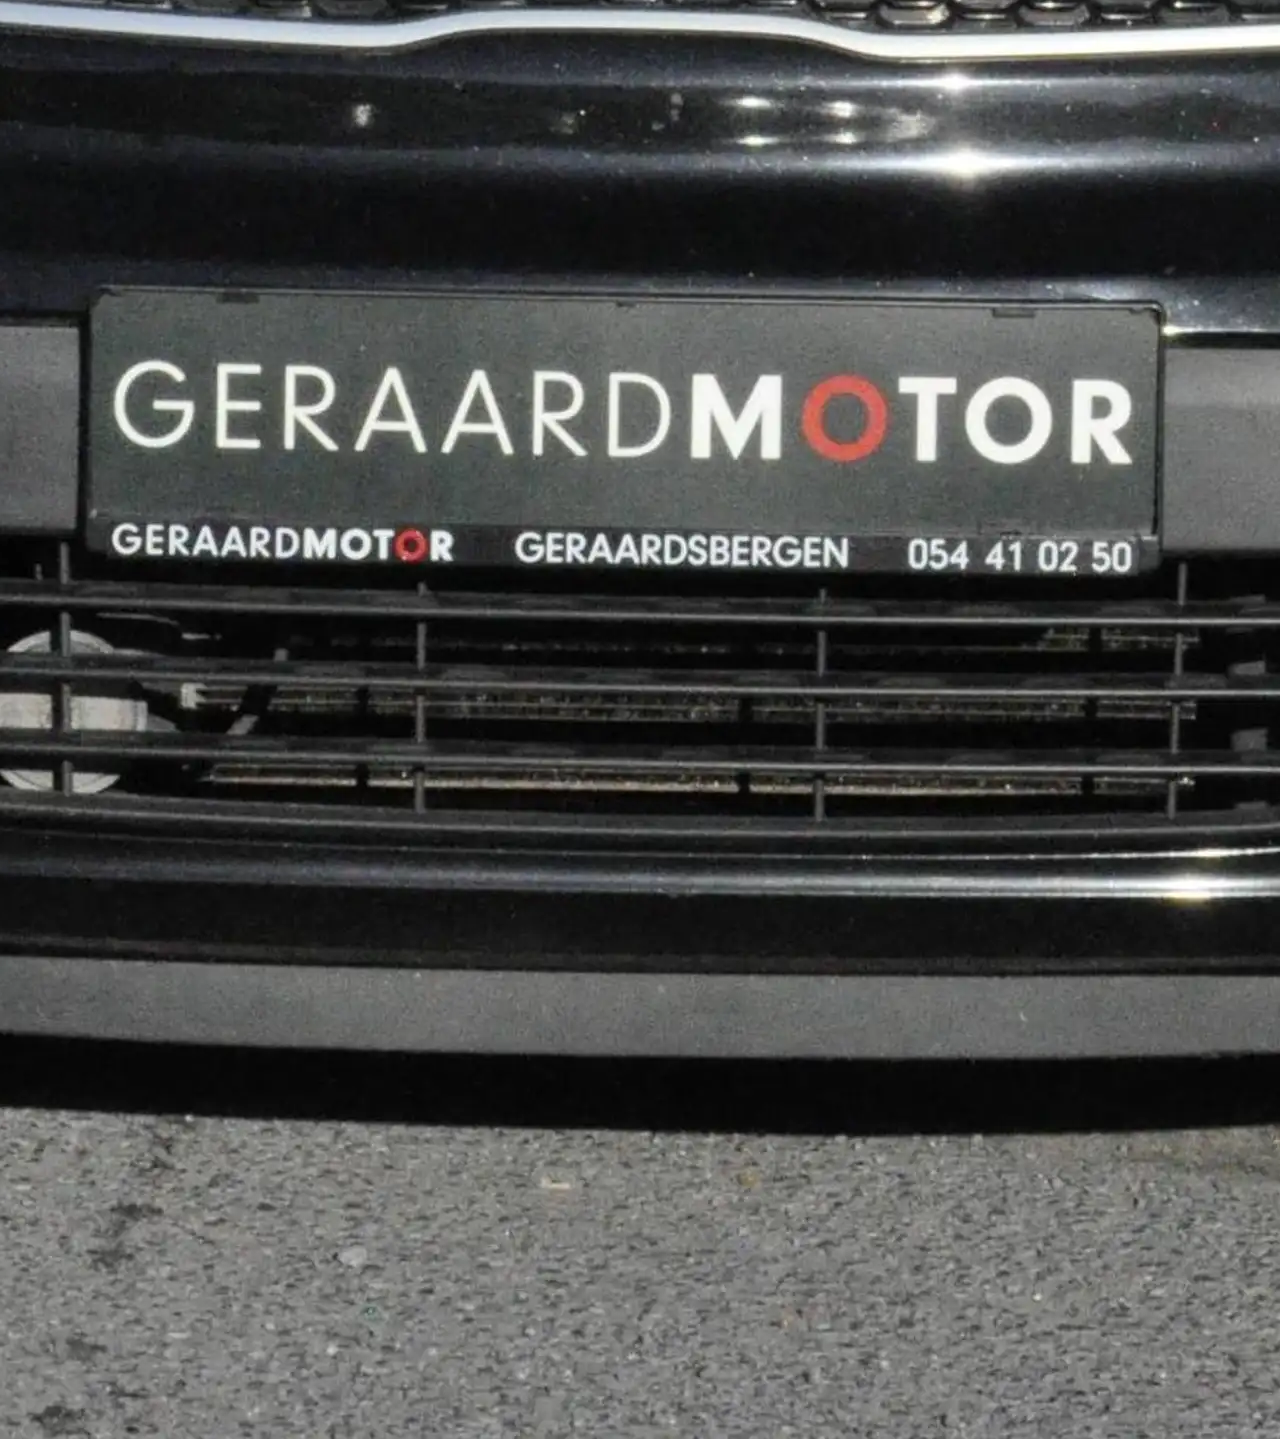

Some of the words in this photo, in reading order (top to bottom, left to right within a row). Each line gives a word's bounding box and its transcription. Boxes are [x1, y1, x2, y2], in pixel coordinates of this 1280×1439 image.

[113, 359, 1133, 465] GERAARDMOTOR
[111, 522, 454, 563] GERAARDMOTOR
[514, 532, 850, 569] GERAARDSBERGEN
[908, 538, 970, 571] 054
[984, 540, 1022, 571] 41
[1038, 541, 1079, 573] 02
[1091, 542, 1132, 573] 50
